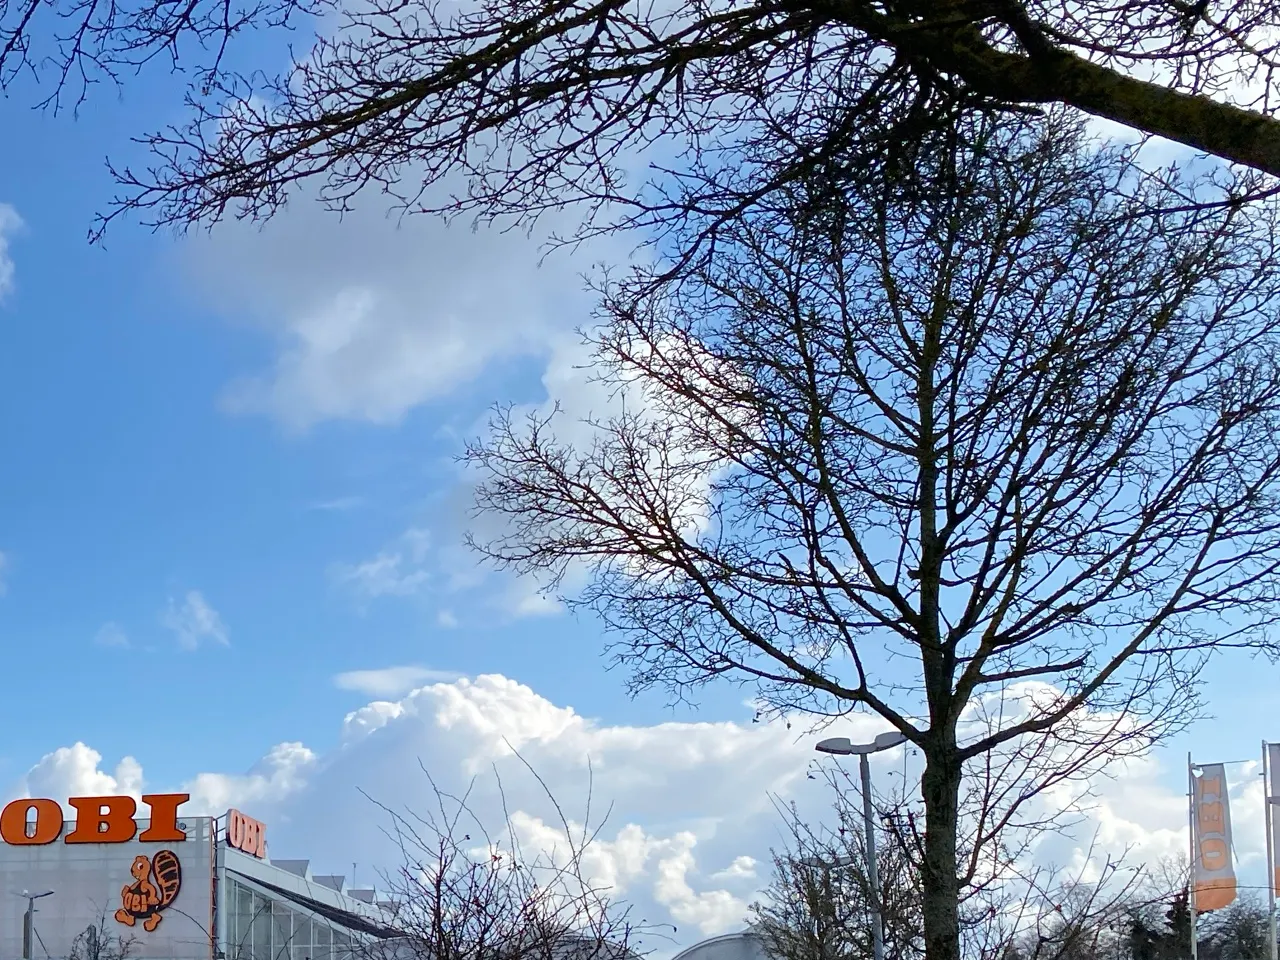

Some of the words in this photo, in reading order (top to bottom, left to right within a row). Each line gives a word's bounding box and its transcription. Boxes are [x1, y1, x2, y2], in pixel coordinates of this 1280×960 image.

[0, 793, 190, 846] OBI
[226, 808, 267, 859] OBI
[1198, 775, 1227, 872] OBI
[123, 890, 148, 912] OBI
